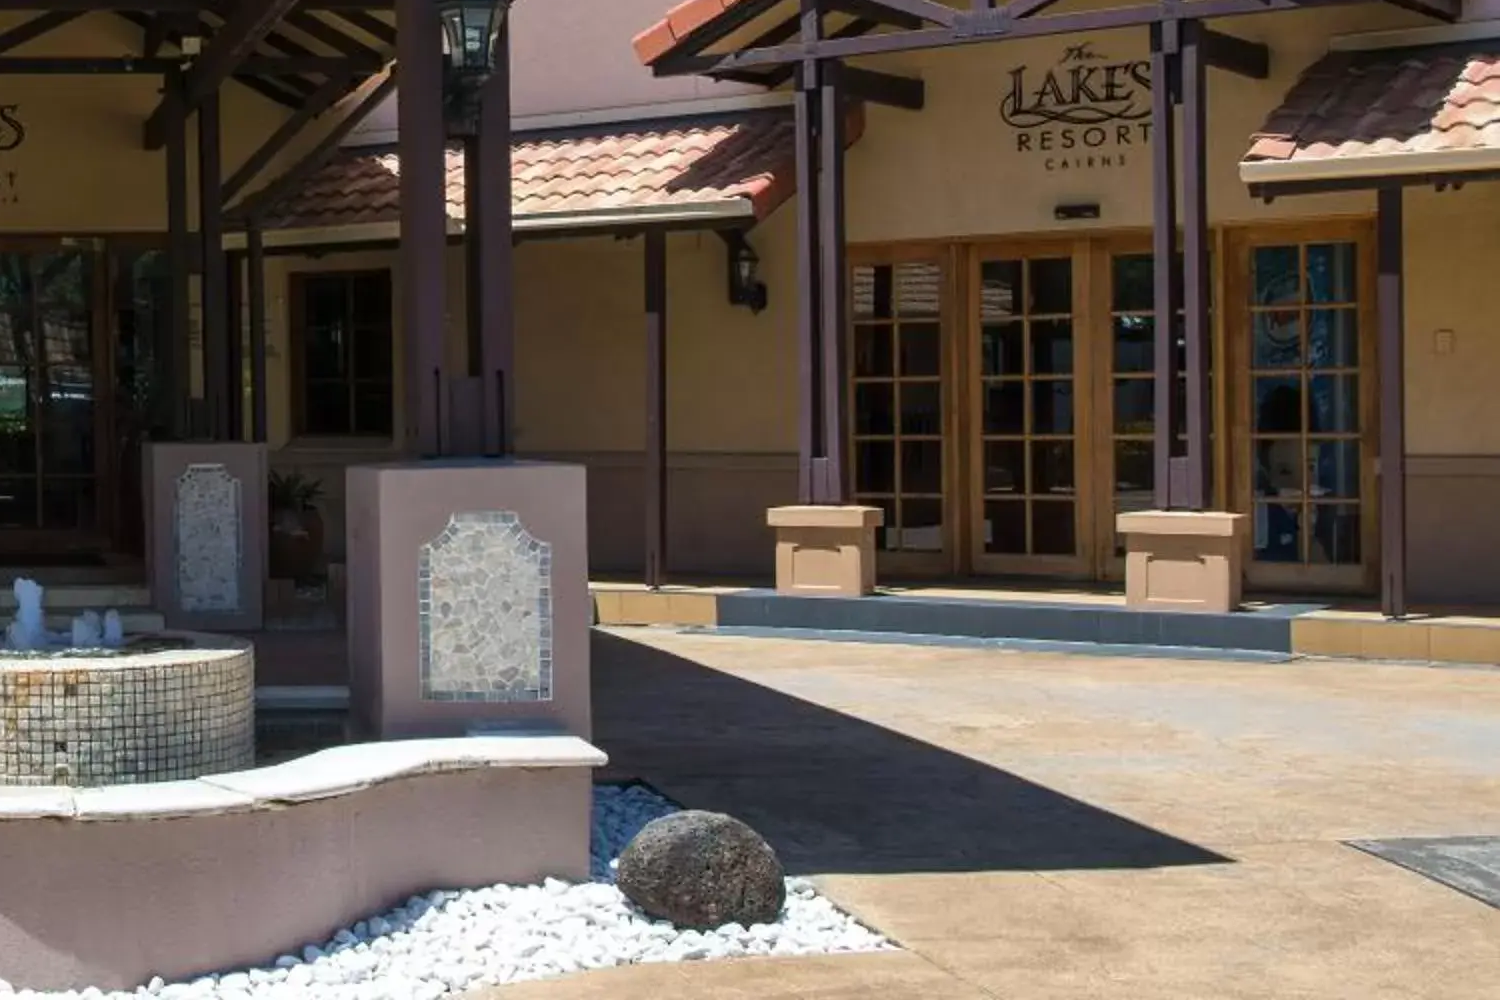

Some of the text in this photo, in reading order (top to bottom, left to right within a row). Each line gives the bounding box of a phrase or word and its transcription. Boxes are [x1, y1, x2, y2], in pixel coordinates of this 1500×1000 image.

[1059, 41, 1109, 64] The
[1000, 61, 1153, 128] LAKES
[1016, 123, 1153, 152] RESORT
[1044, 154, 1126, 171] CAIRNS
